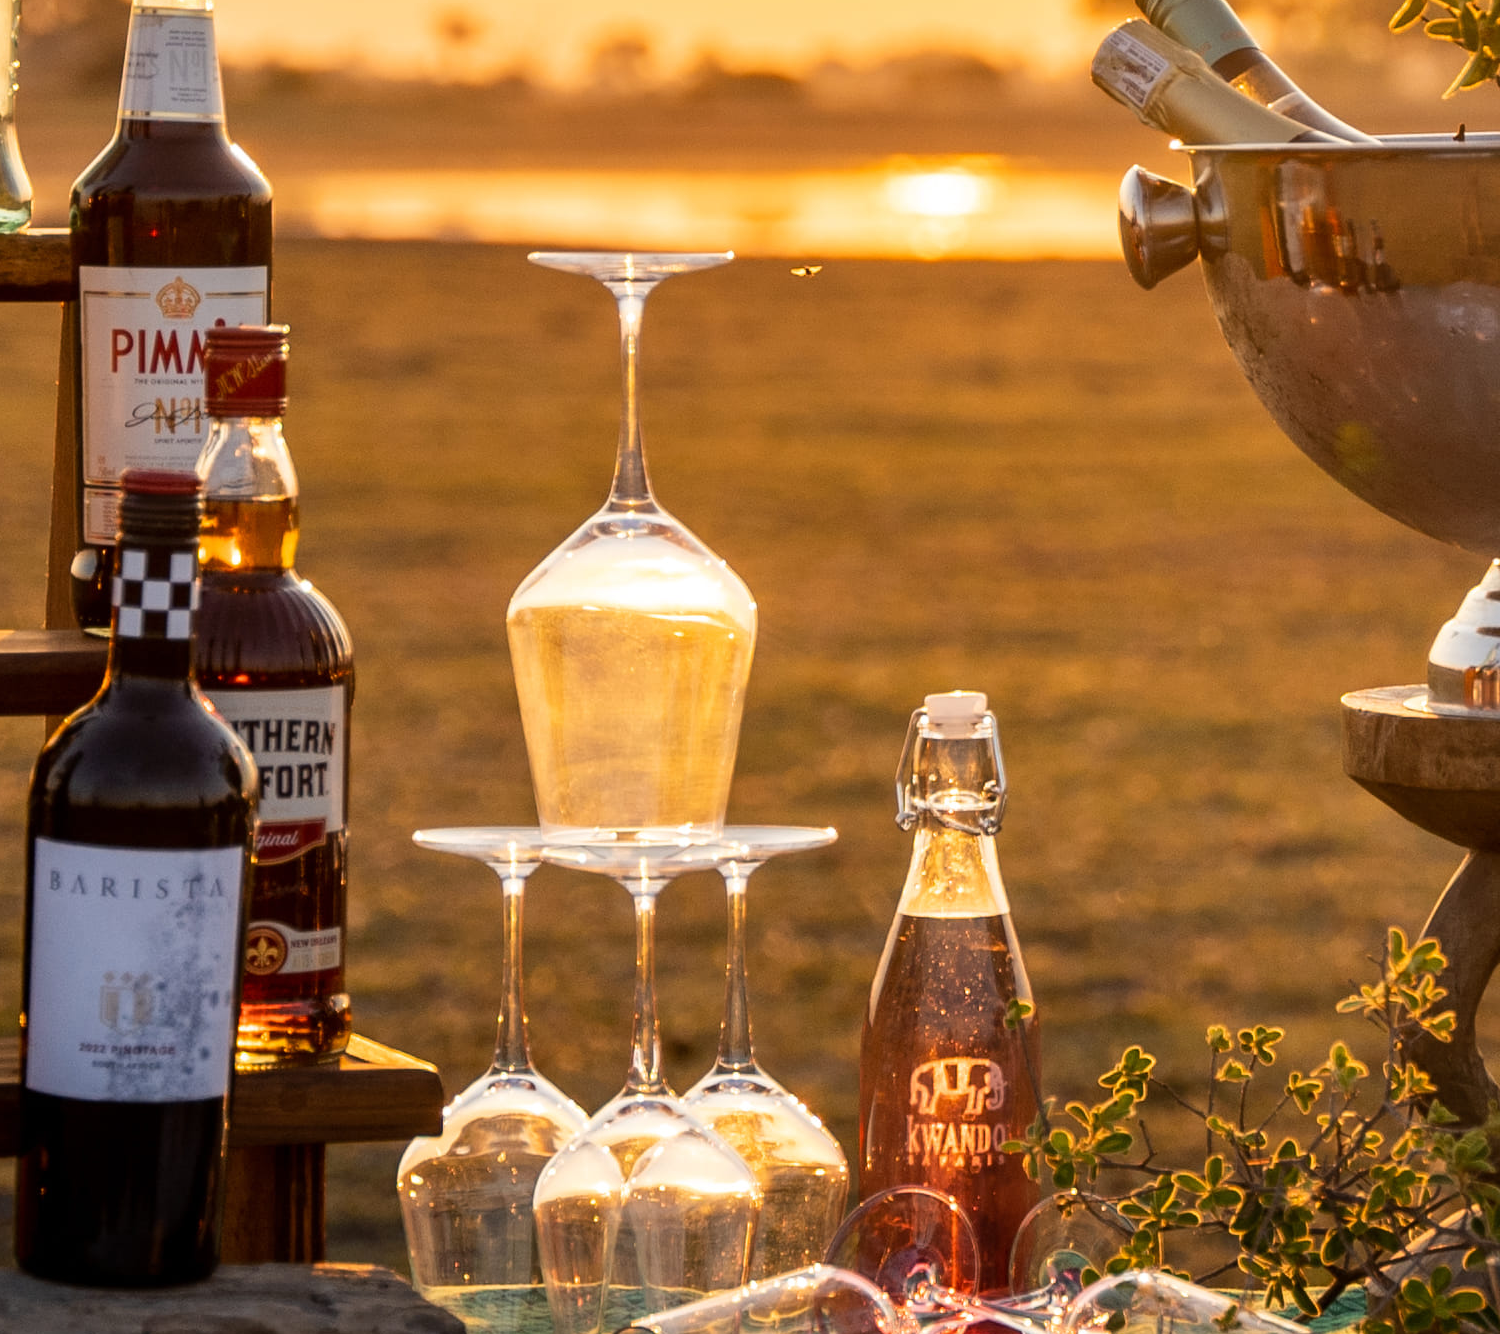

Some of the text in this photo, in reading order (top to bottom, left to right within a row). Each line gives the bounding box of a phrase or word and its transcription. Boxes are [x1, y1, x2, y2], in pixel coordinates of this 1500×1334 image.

[234, 719, 335, 755] THERN
[259, 763, 328, 800] FORT
[257, 830, 299, 850] ginal
[49, 870, 224, 899] BARISTA
